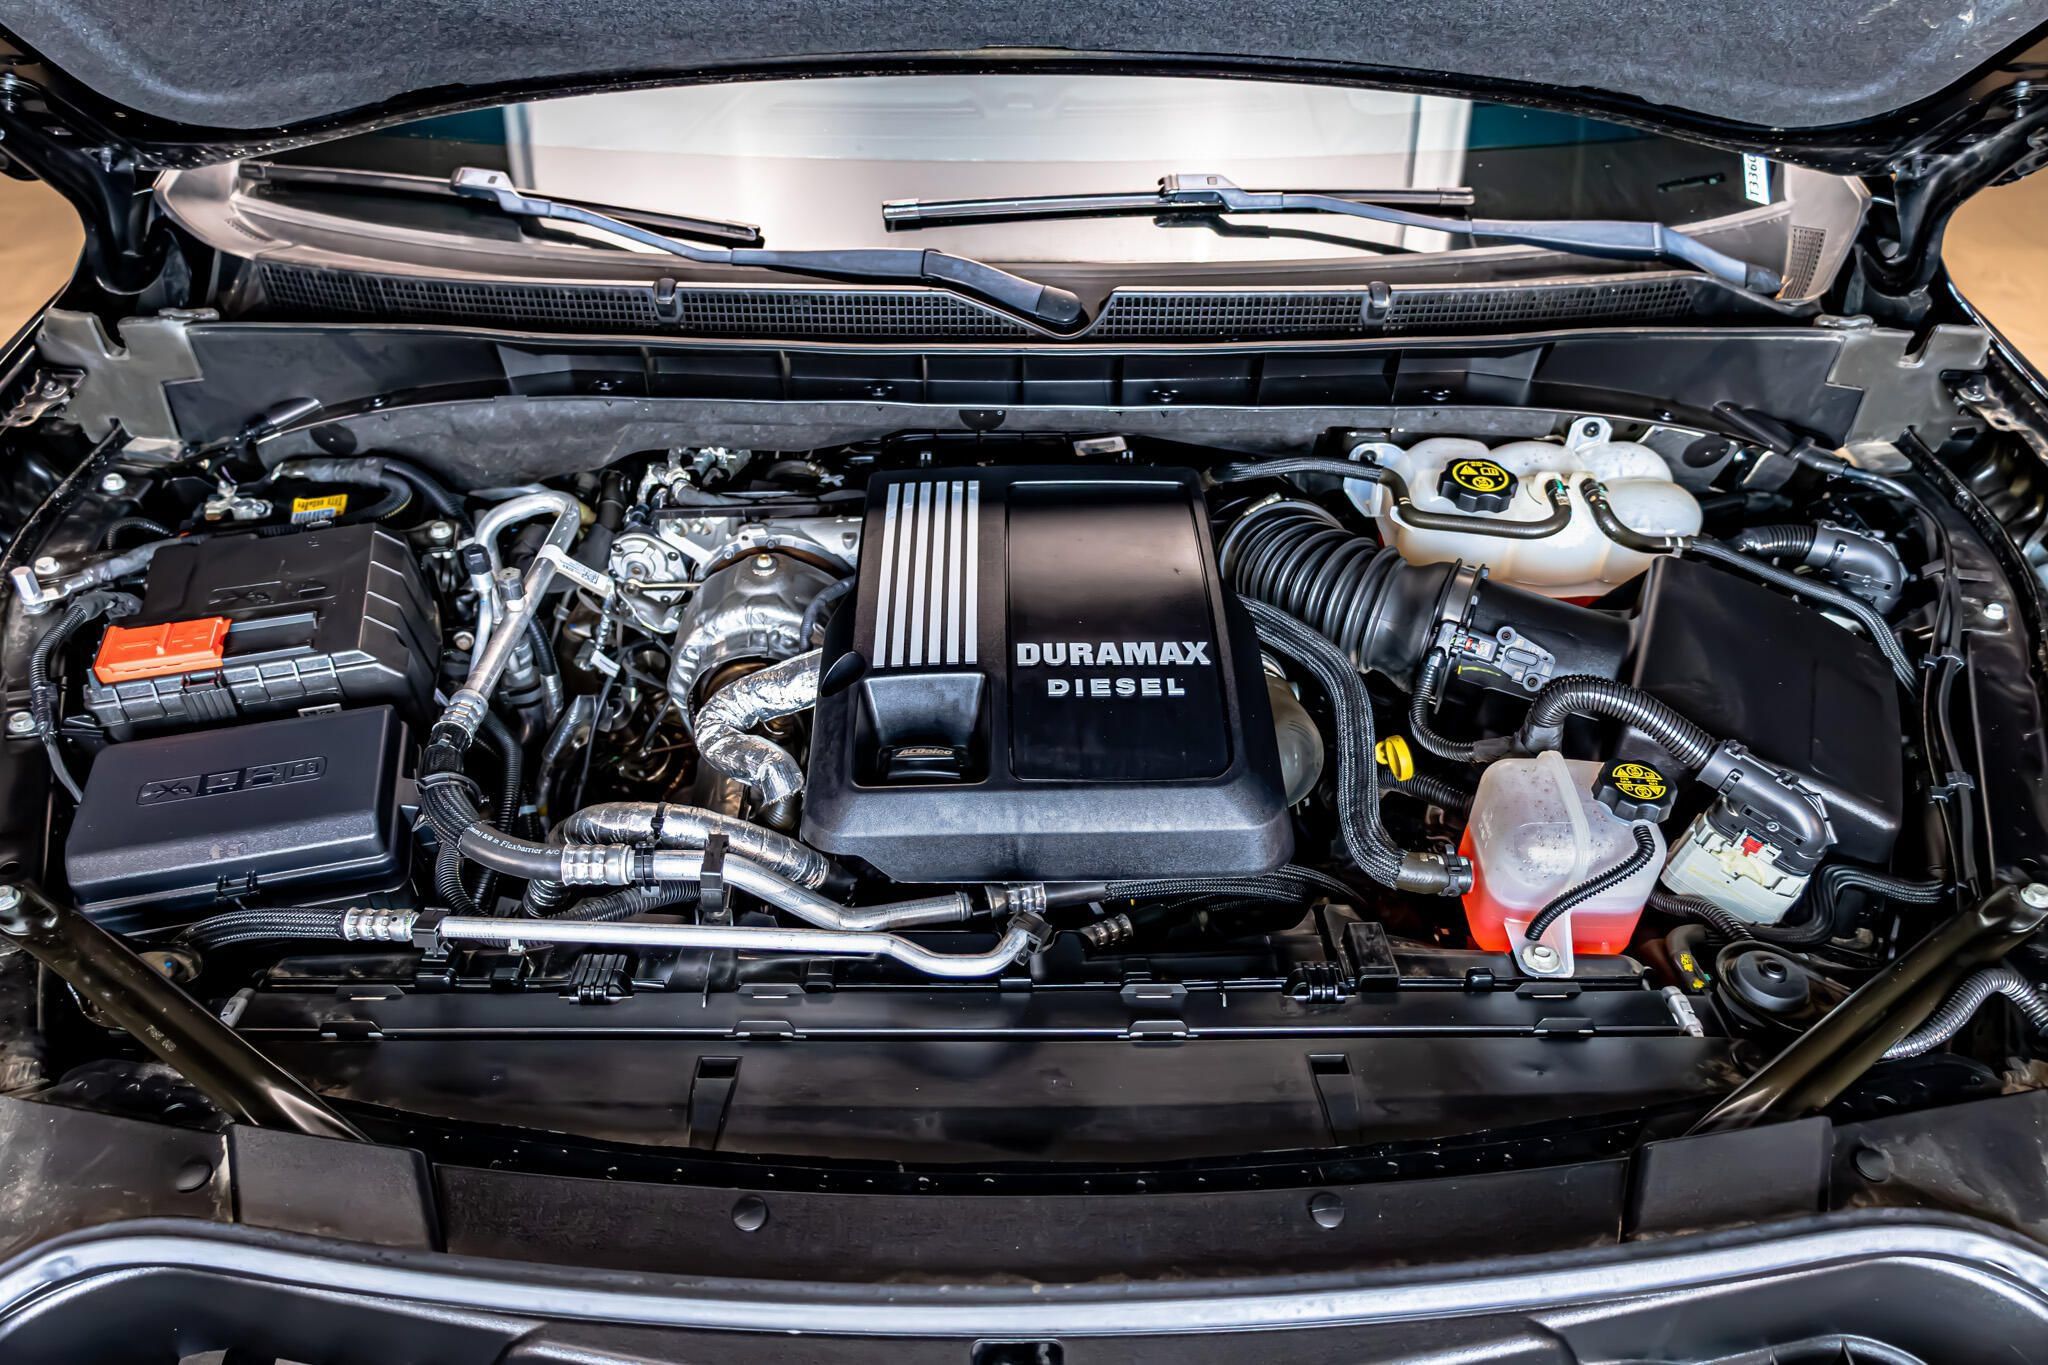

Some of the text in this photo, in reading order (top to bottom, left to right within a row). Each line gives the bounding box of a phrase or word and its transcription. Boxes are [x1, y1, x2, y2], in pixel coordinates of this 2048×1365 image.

[1016, 641, 1211, 666] DURAMAX
[1047, 678, 1185, 697] DIESEL
[500, 840, 543, 854] Flexbarrier
